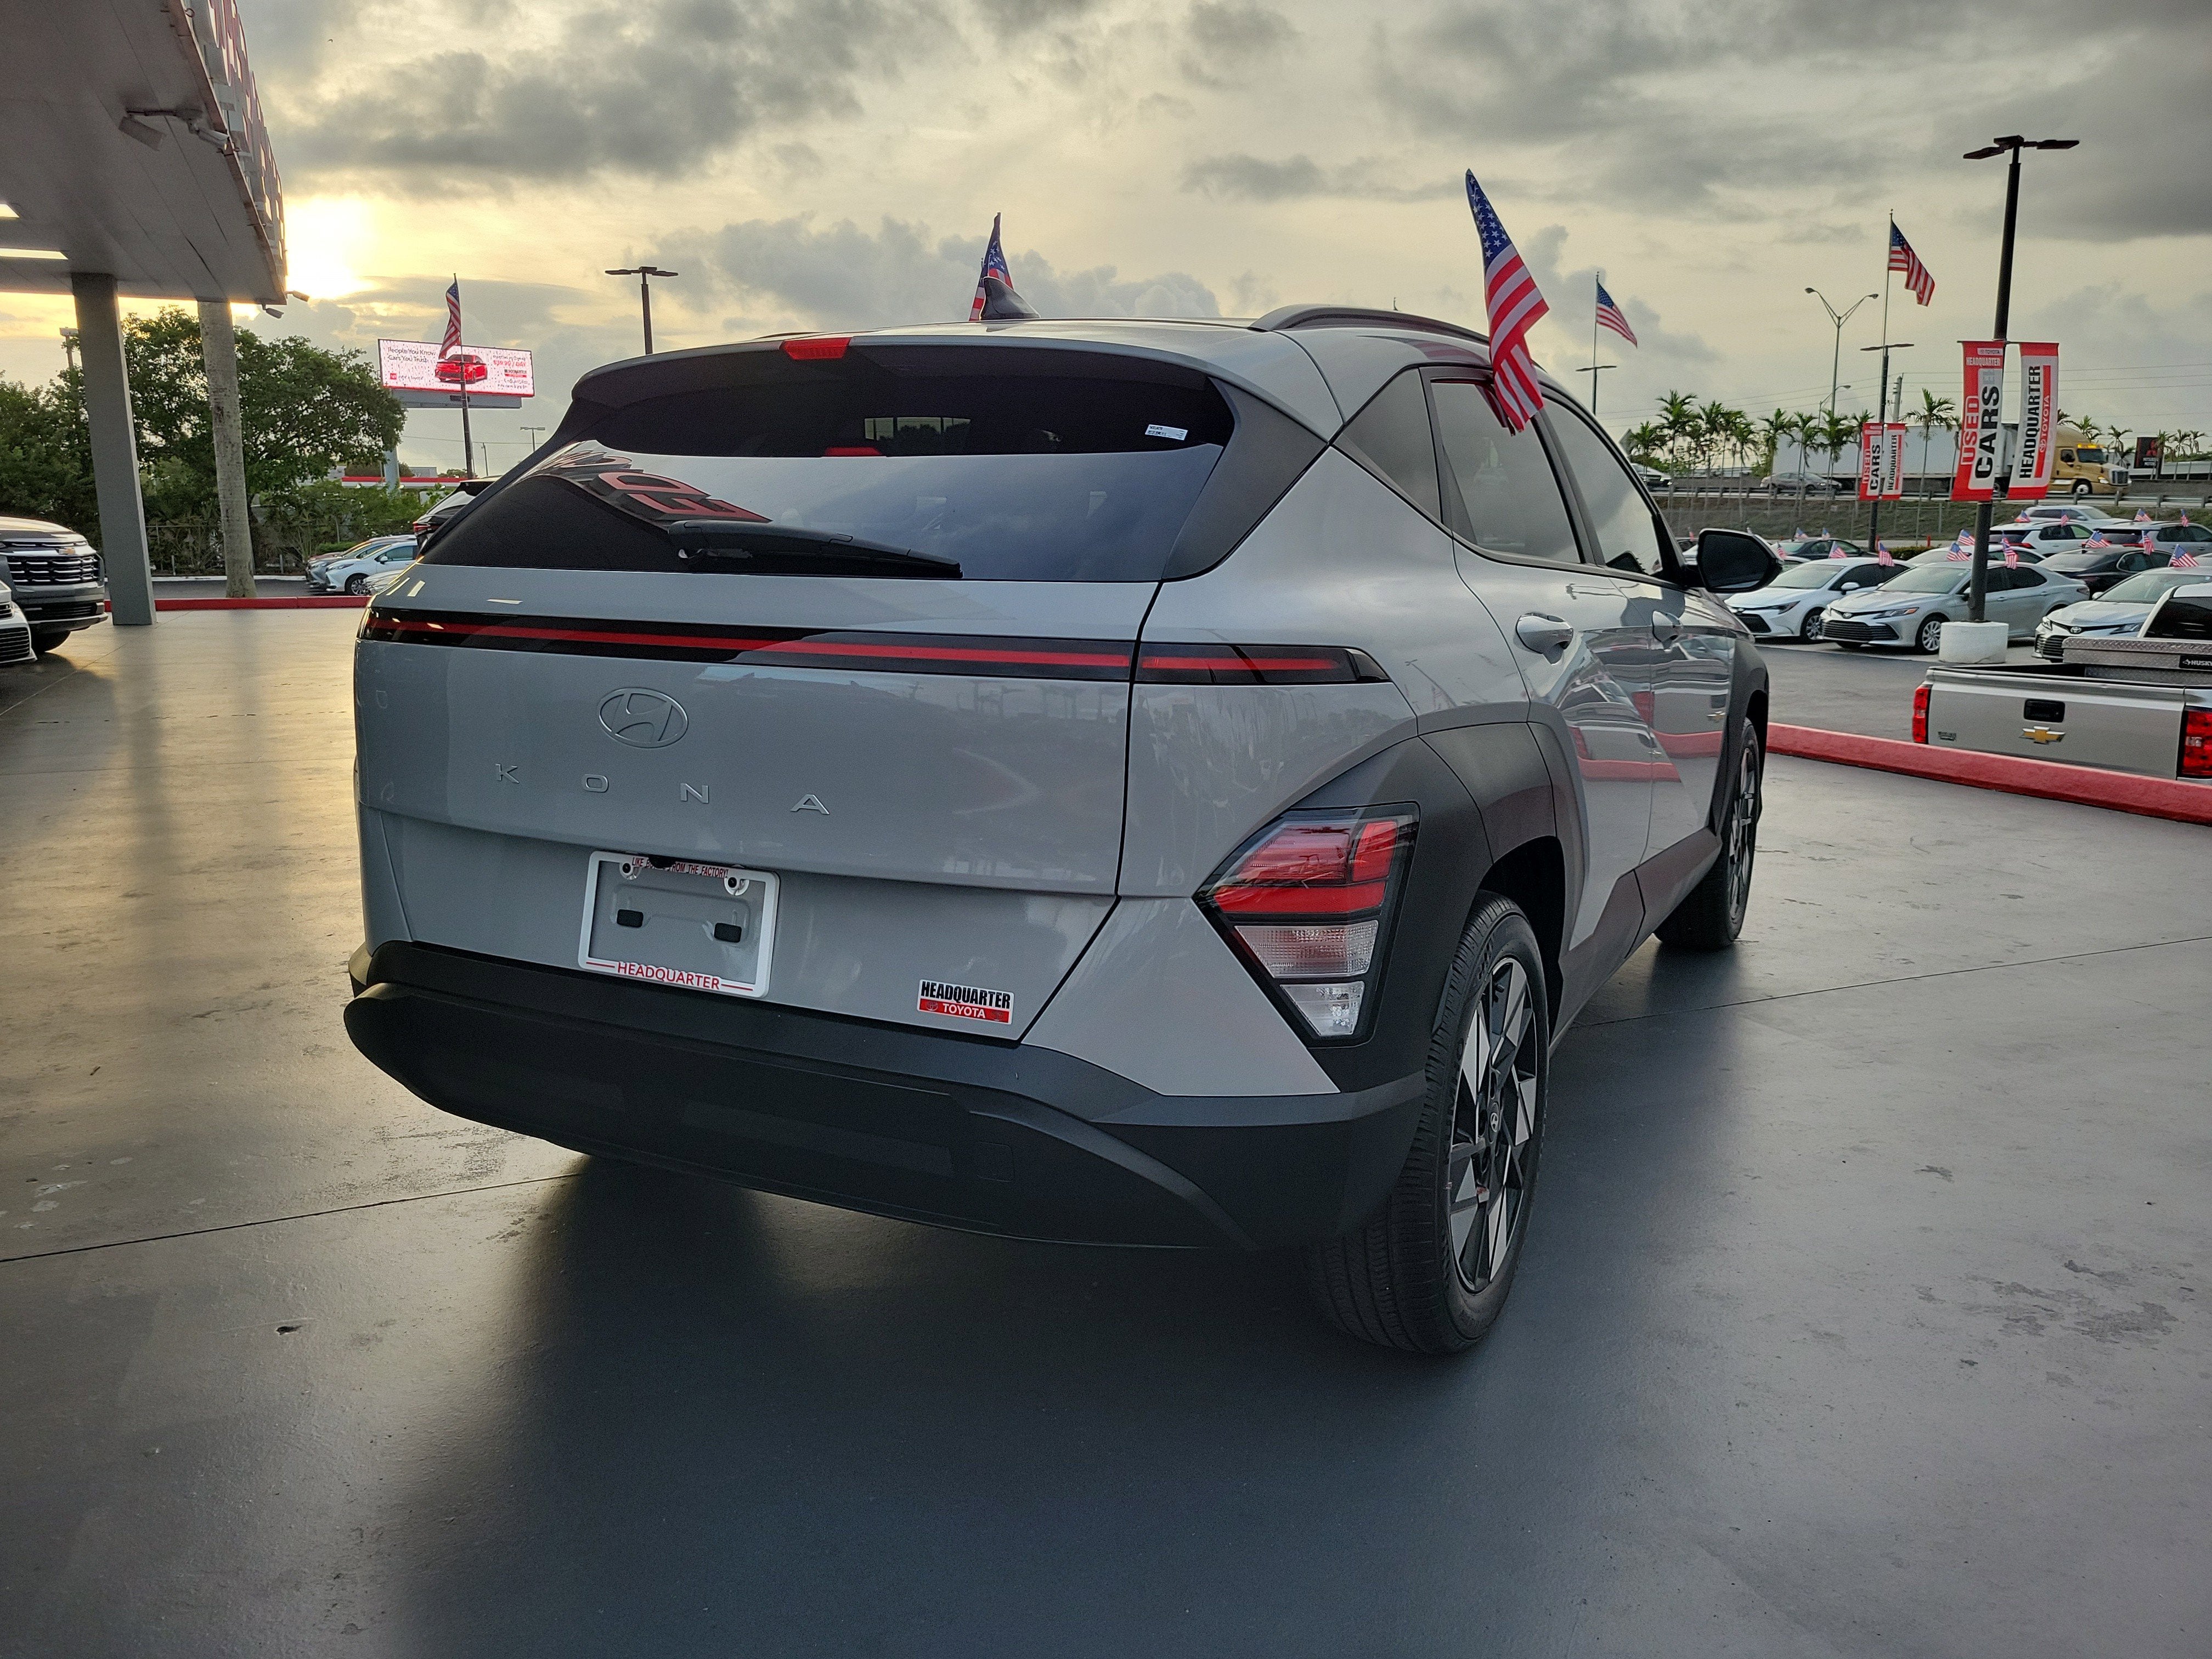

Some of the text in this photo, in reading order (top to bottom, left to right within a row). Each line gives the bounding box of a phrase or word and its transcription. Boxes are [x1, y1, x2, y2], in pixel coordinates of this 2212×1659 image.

[1966, 357, 2001, 366] HEADQUARTER
[1960, 395, 1979, 465] USED
[1975, 386, 1999, 478] CARS
[2019, 366, 2041, 478] HEADQUARTER
[2041, 395, 2050, 437] TOYOTA
[1862, 449, 1871, 484] USED
[1870, 444, 1881, 490] CARS
[494, 763, 831, 815] KONA
[632, 857, 644, 866] LIKE
[687, 865, 699, 874] THE
[700, 866, 729, 878] FACTORY!
[617, 961, 720, 990] HEADQUARTER
[921, 981, 1011, 1009] HEADQUARTER
[943, 1003, 986, 1018] TOYOTA
